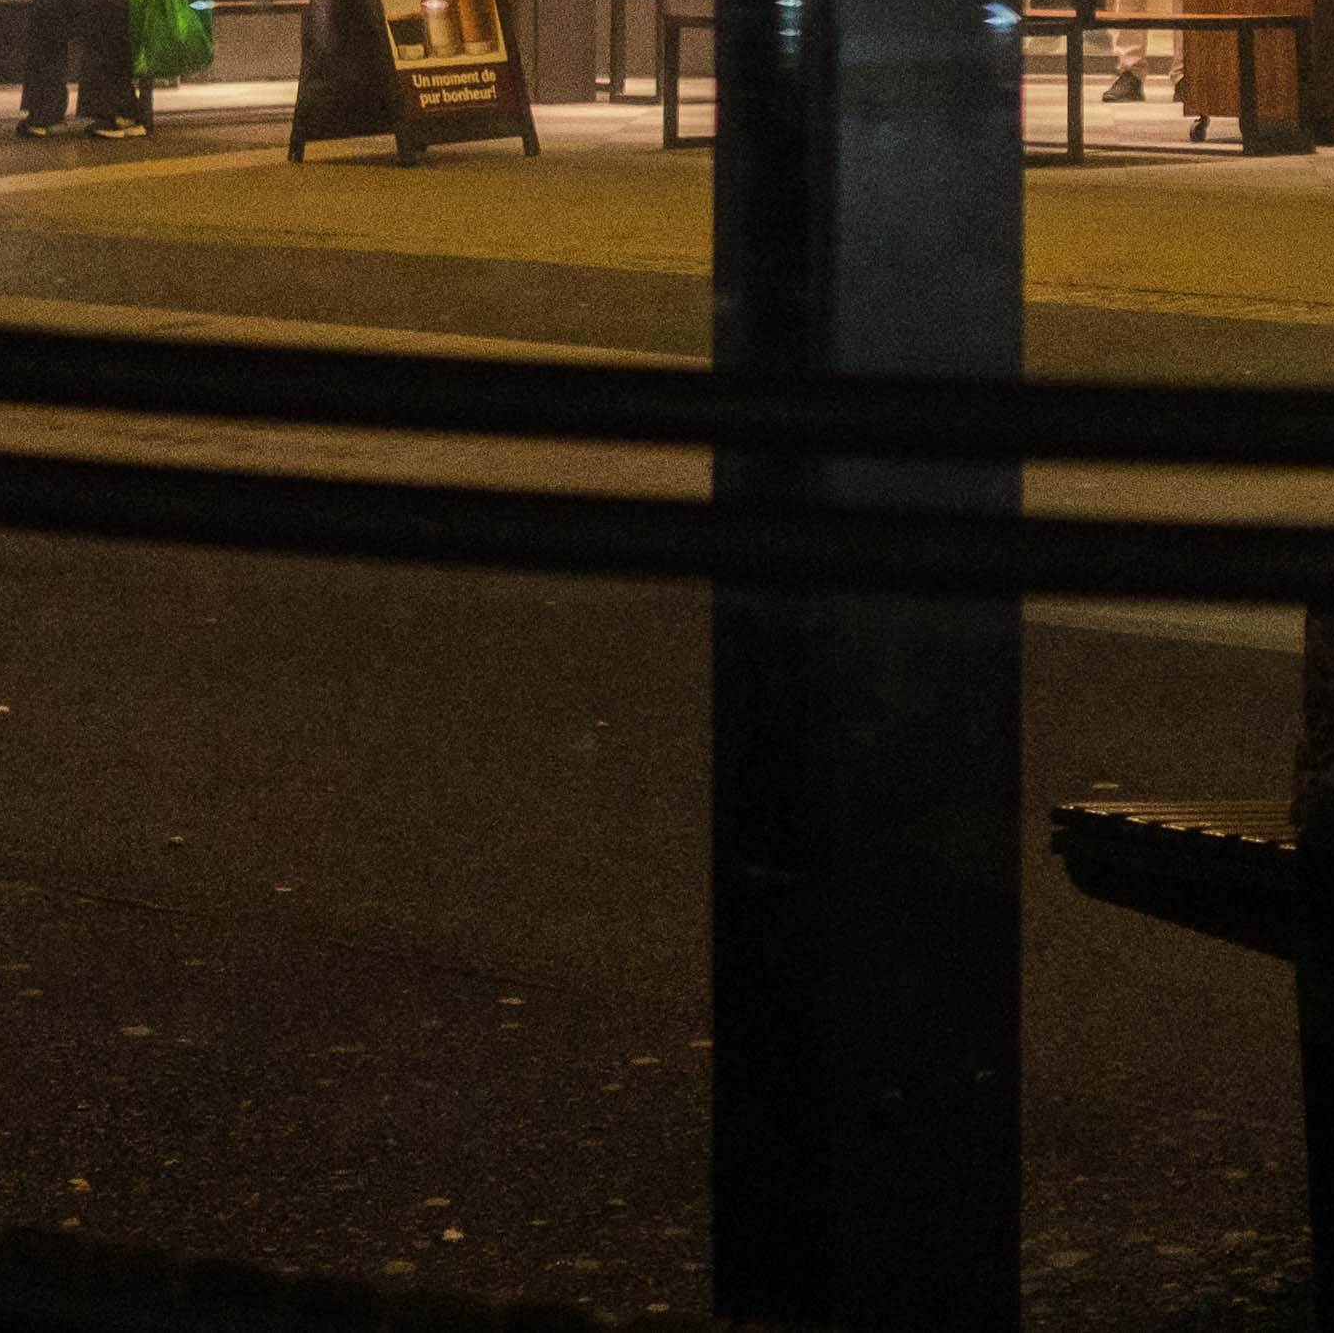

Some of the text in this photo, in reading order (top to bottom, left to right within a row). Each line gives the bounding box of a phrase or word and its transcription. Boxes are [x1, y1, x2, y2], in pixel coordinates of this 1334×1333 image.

[412, 69, 497, 88] Un moment de
[419, 91, 441, 109] pur
